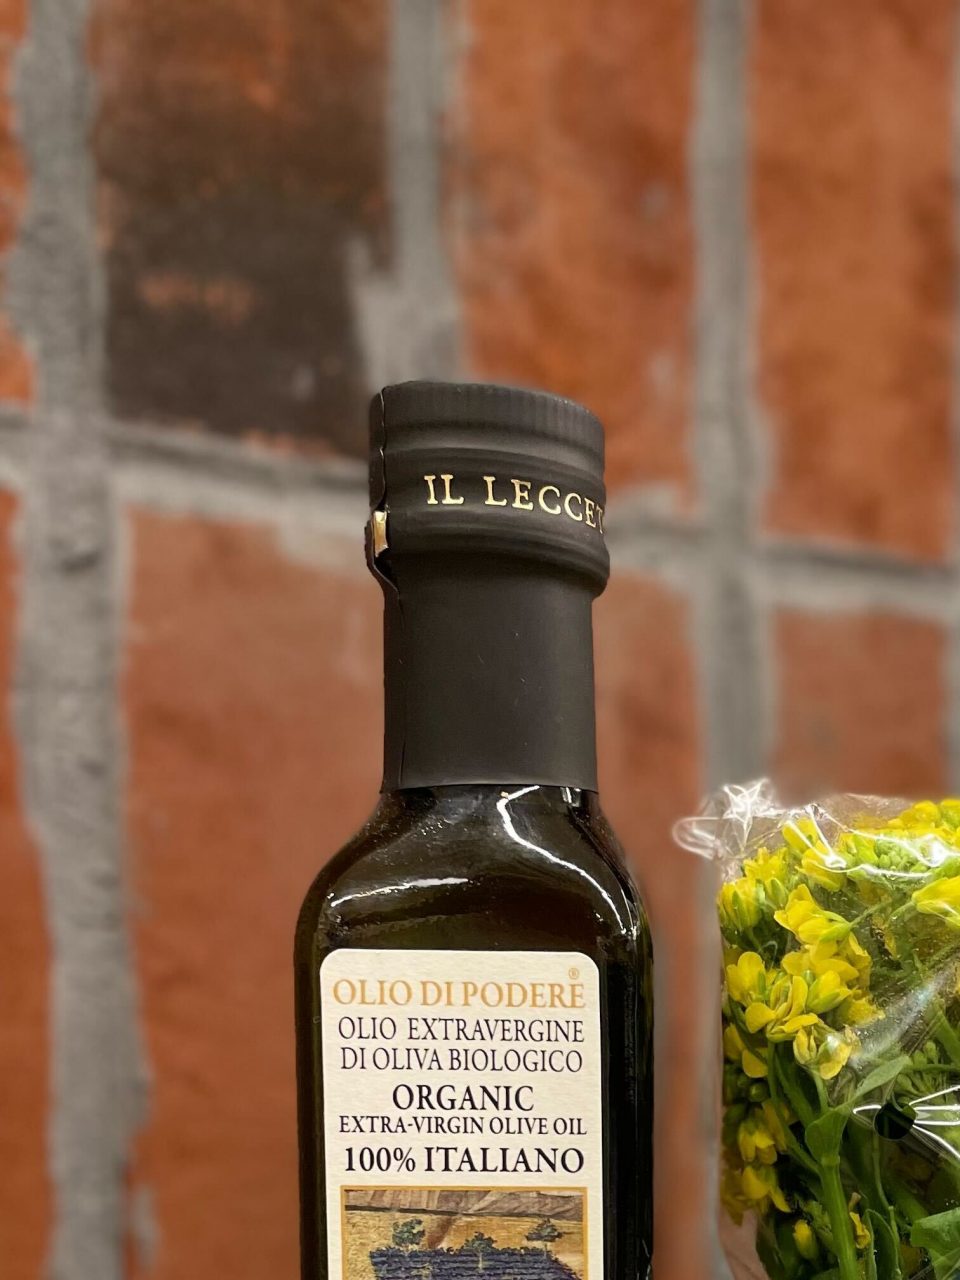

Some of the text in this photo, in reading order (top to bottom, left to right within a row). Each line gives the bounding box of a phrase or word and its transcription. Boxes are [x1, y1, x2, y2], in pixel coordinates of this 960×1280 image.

[424, 475, 604, 534] IL LECCET
[333, 980, 413, 1006] OLIO
[421, 981, 459, 1006] DI
[338, 1017, 584, 1042] OLIO EXTRAVERGINE
[341, 1047, 583, 1072] DI OLIVA BIOLOGICO
[393, 1084, 534, 1111] ORGANIC
[339, 1116, 587, 1135] EXTRA-VIRGIN OLIVE OIL
[345, 1147, 584, 1174] 100% ITALIANO
